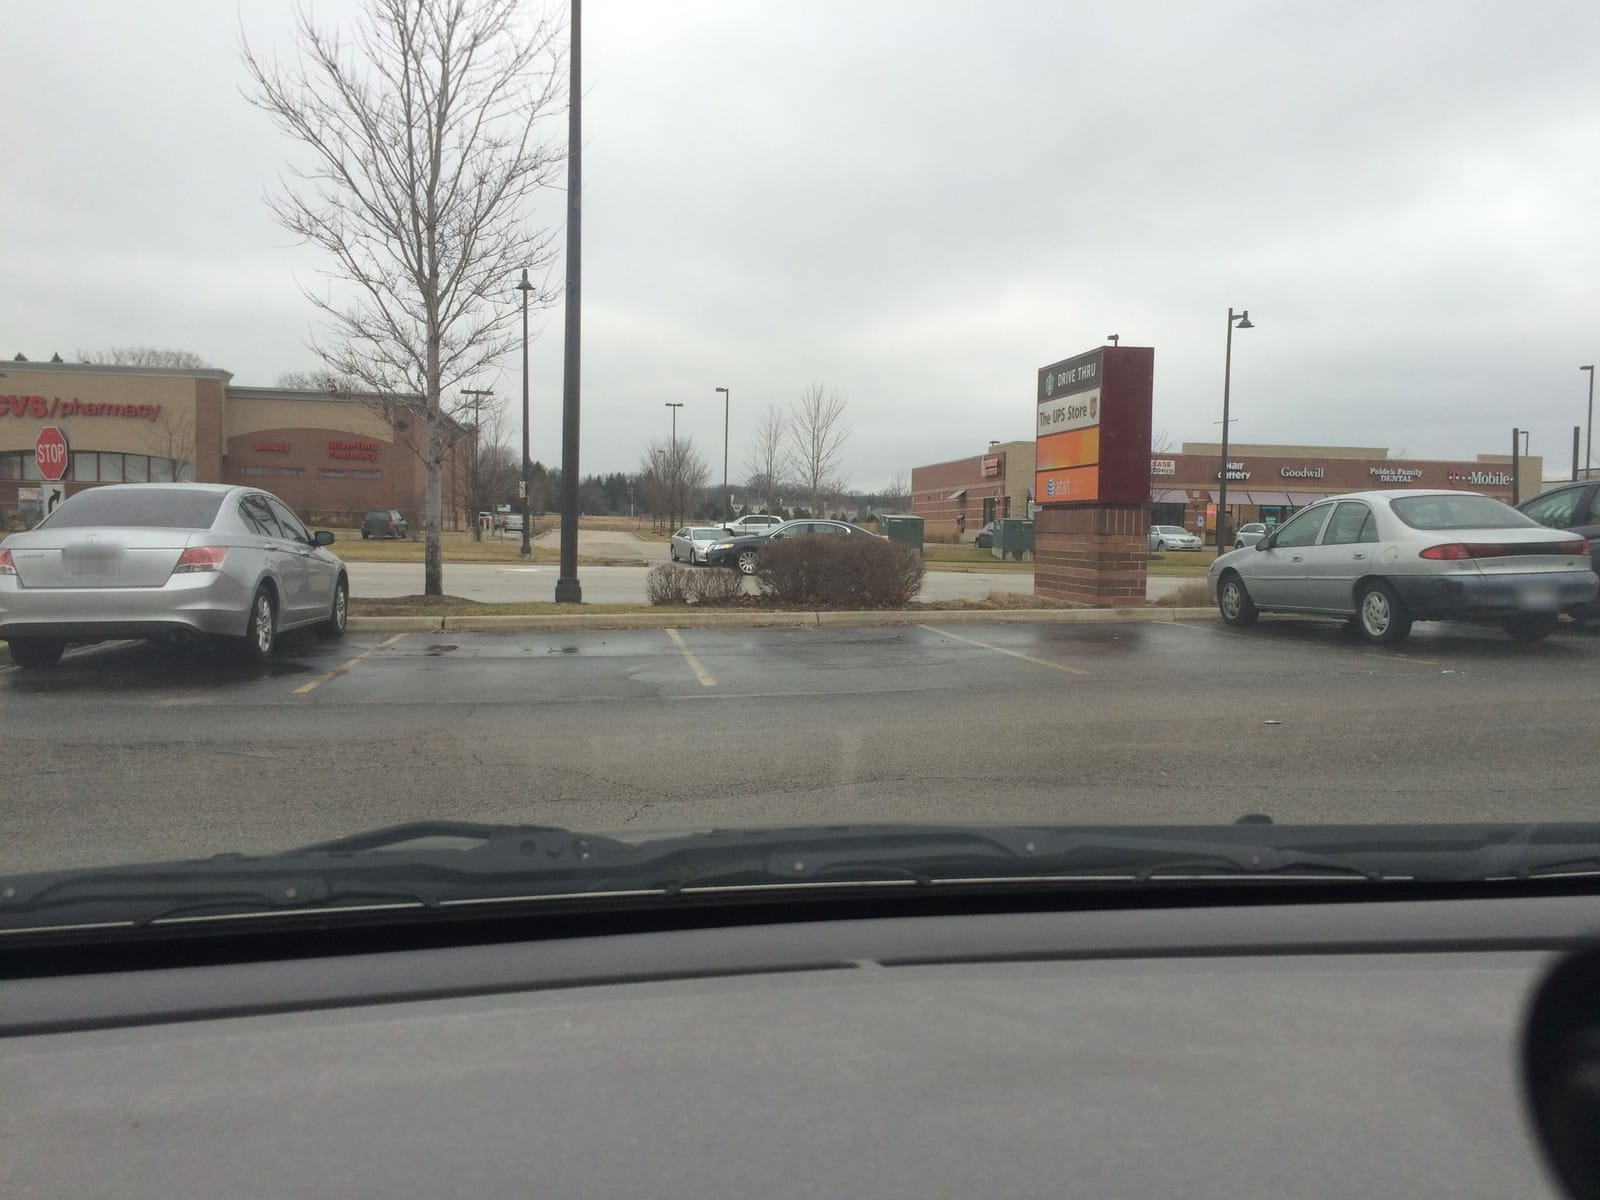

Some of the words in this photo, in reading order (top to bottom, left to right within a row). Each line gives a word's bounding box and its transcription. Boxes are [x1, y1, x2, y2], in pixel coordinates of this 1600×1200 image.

[1057, 369, 1076, 386] DRIVE
[1078, 363, 1096, 380] THRU
[1040, 411, 1051, 427] The
[1052, 406, 1066, 423] UPS
[1067, 405, 1087, 420] Store
[38, 443, 65, 464] STOP
[1152, 460, 1172, 468] EASE
[1281, 467, 1324, 478] Goodwill
[1397, 468, 1423, 477] Family
